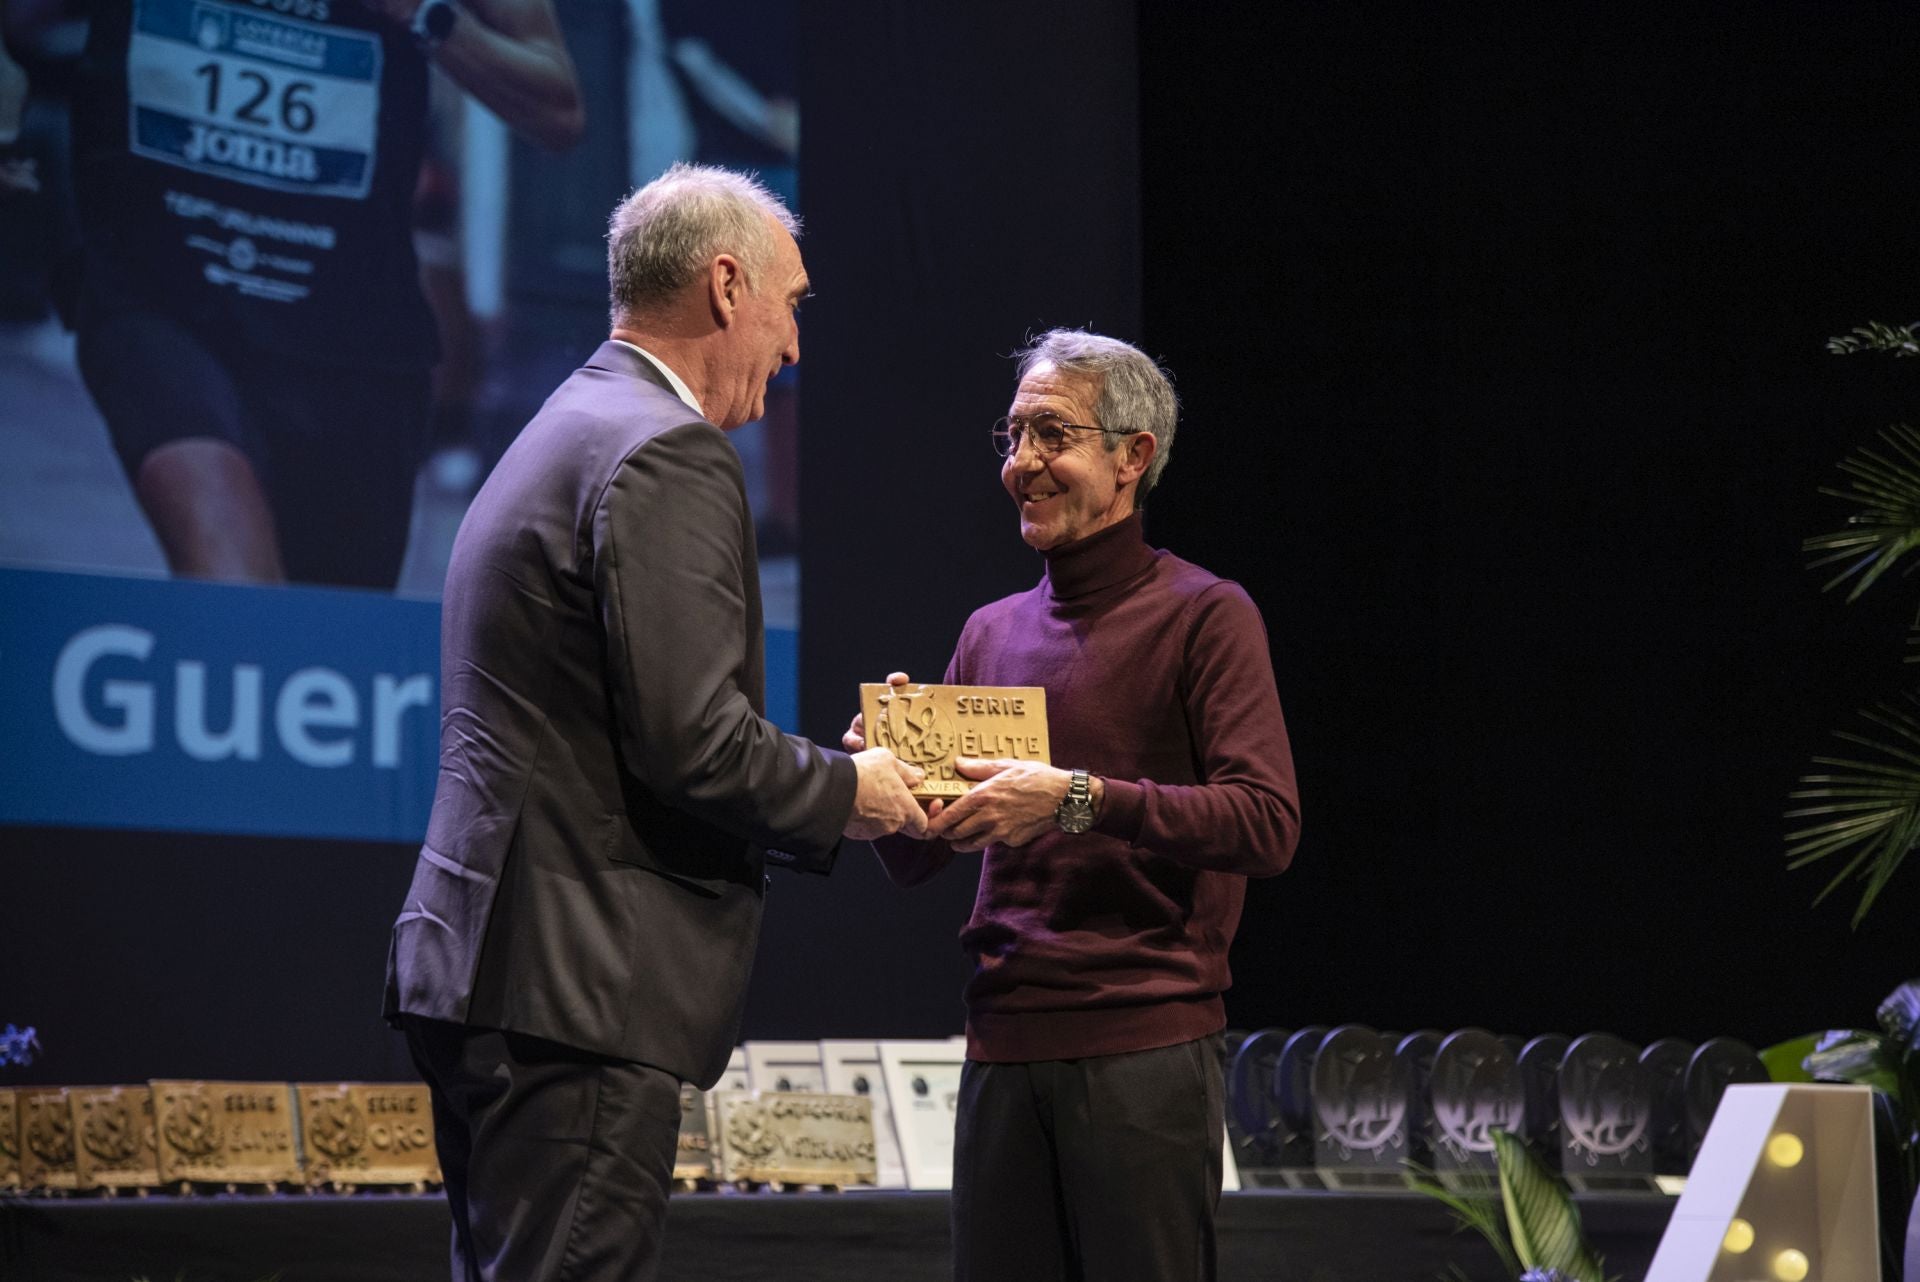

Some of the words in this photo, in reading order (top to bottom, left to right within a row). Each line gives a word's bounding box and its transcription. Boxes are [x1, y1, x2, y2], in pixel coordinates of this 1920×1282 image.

[195, 62, 316, 135] 126
[956, 695, 1026, 717] SERIE
[960, 729, 1041, 759] ÉLITE
[917, 780, 962, 793] AVIER
[369, 1123, 430, 1154] ORO
